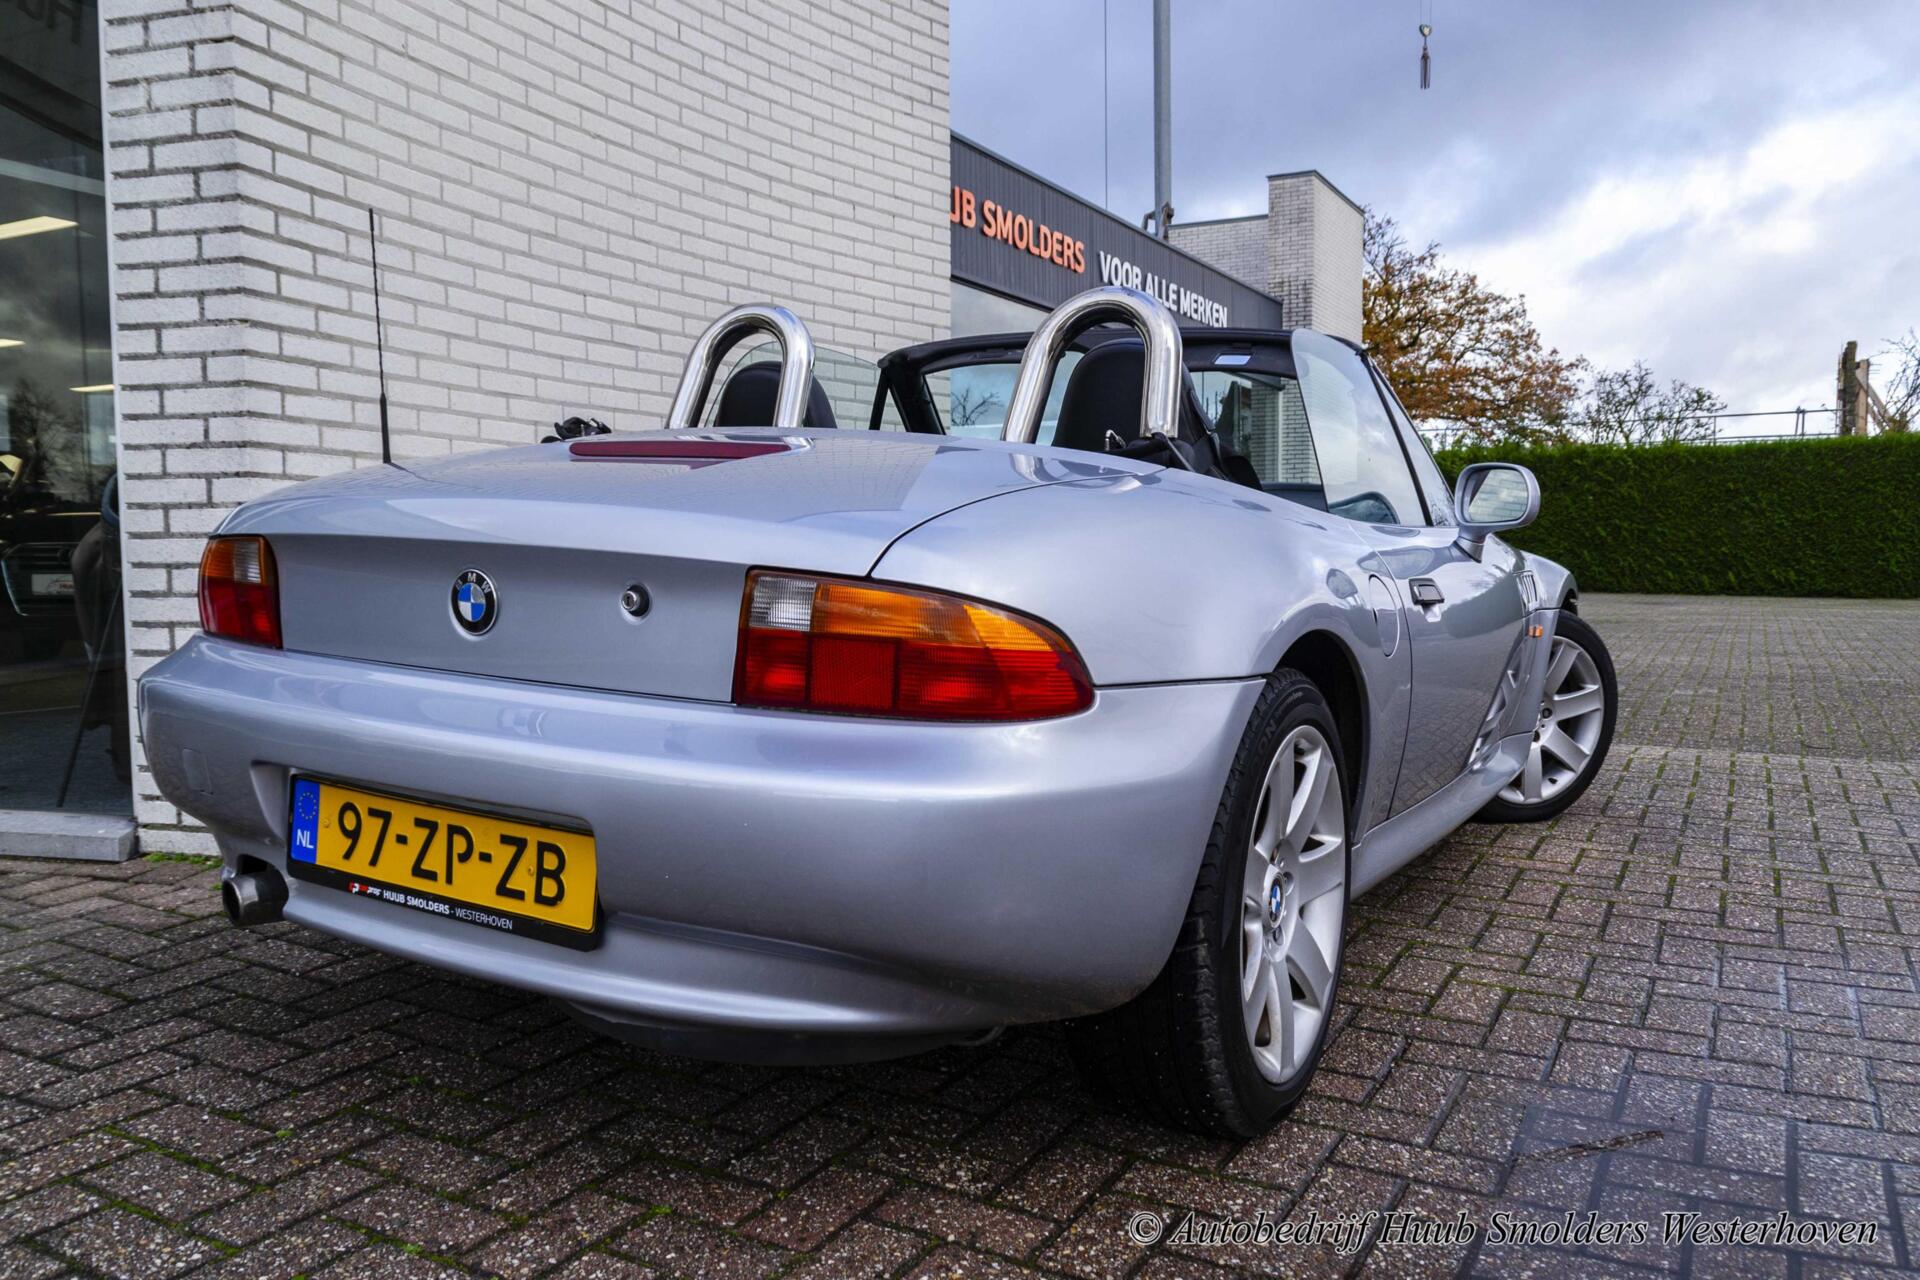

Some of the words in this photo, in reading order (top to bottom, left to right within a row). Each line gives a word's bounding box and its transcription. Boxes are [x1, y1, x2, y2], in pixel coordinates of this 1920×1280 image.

[982, 199, 1086, 274] SMOLDERS
[1100, 250, 1142, 292] VOOR
[1145, 272, 1178, 312] ALLE
[1179, 287, 1228, 328] MERKEN
[455, 572, 492, 594] BMW
[296, 828, 314, 849] NL
[338, 801, 567, 907] 97-ZP-ZB
[383, 889, 405, 904] HUUB
[406, 895, 450, 915] SMOLDERS
[455, 907, 513, 930] WESTERHOVEN
